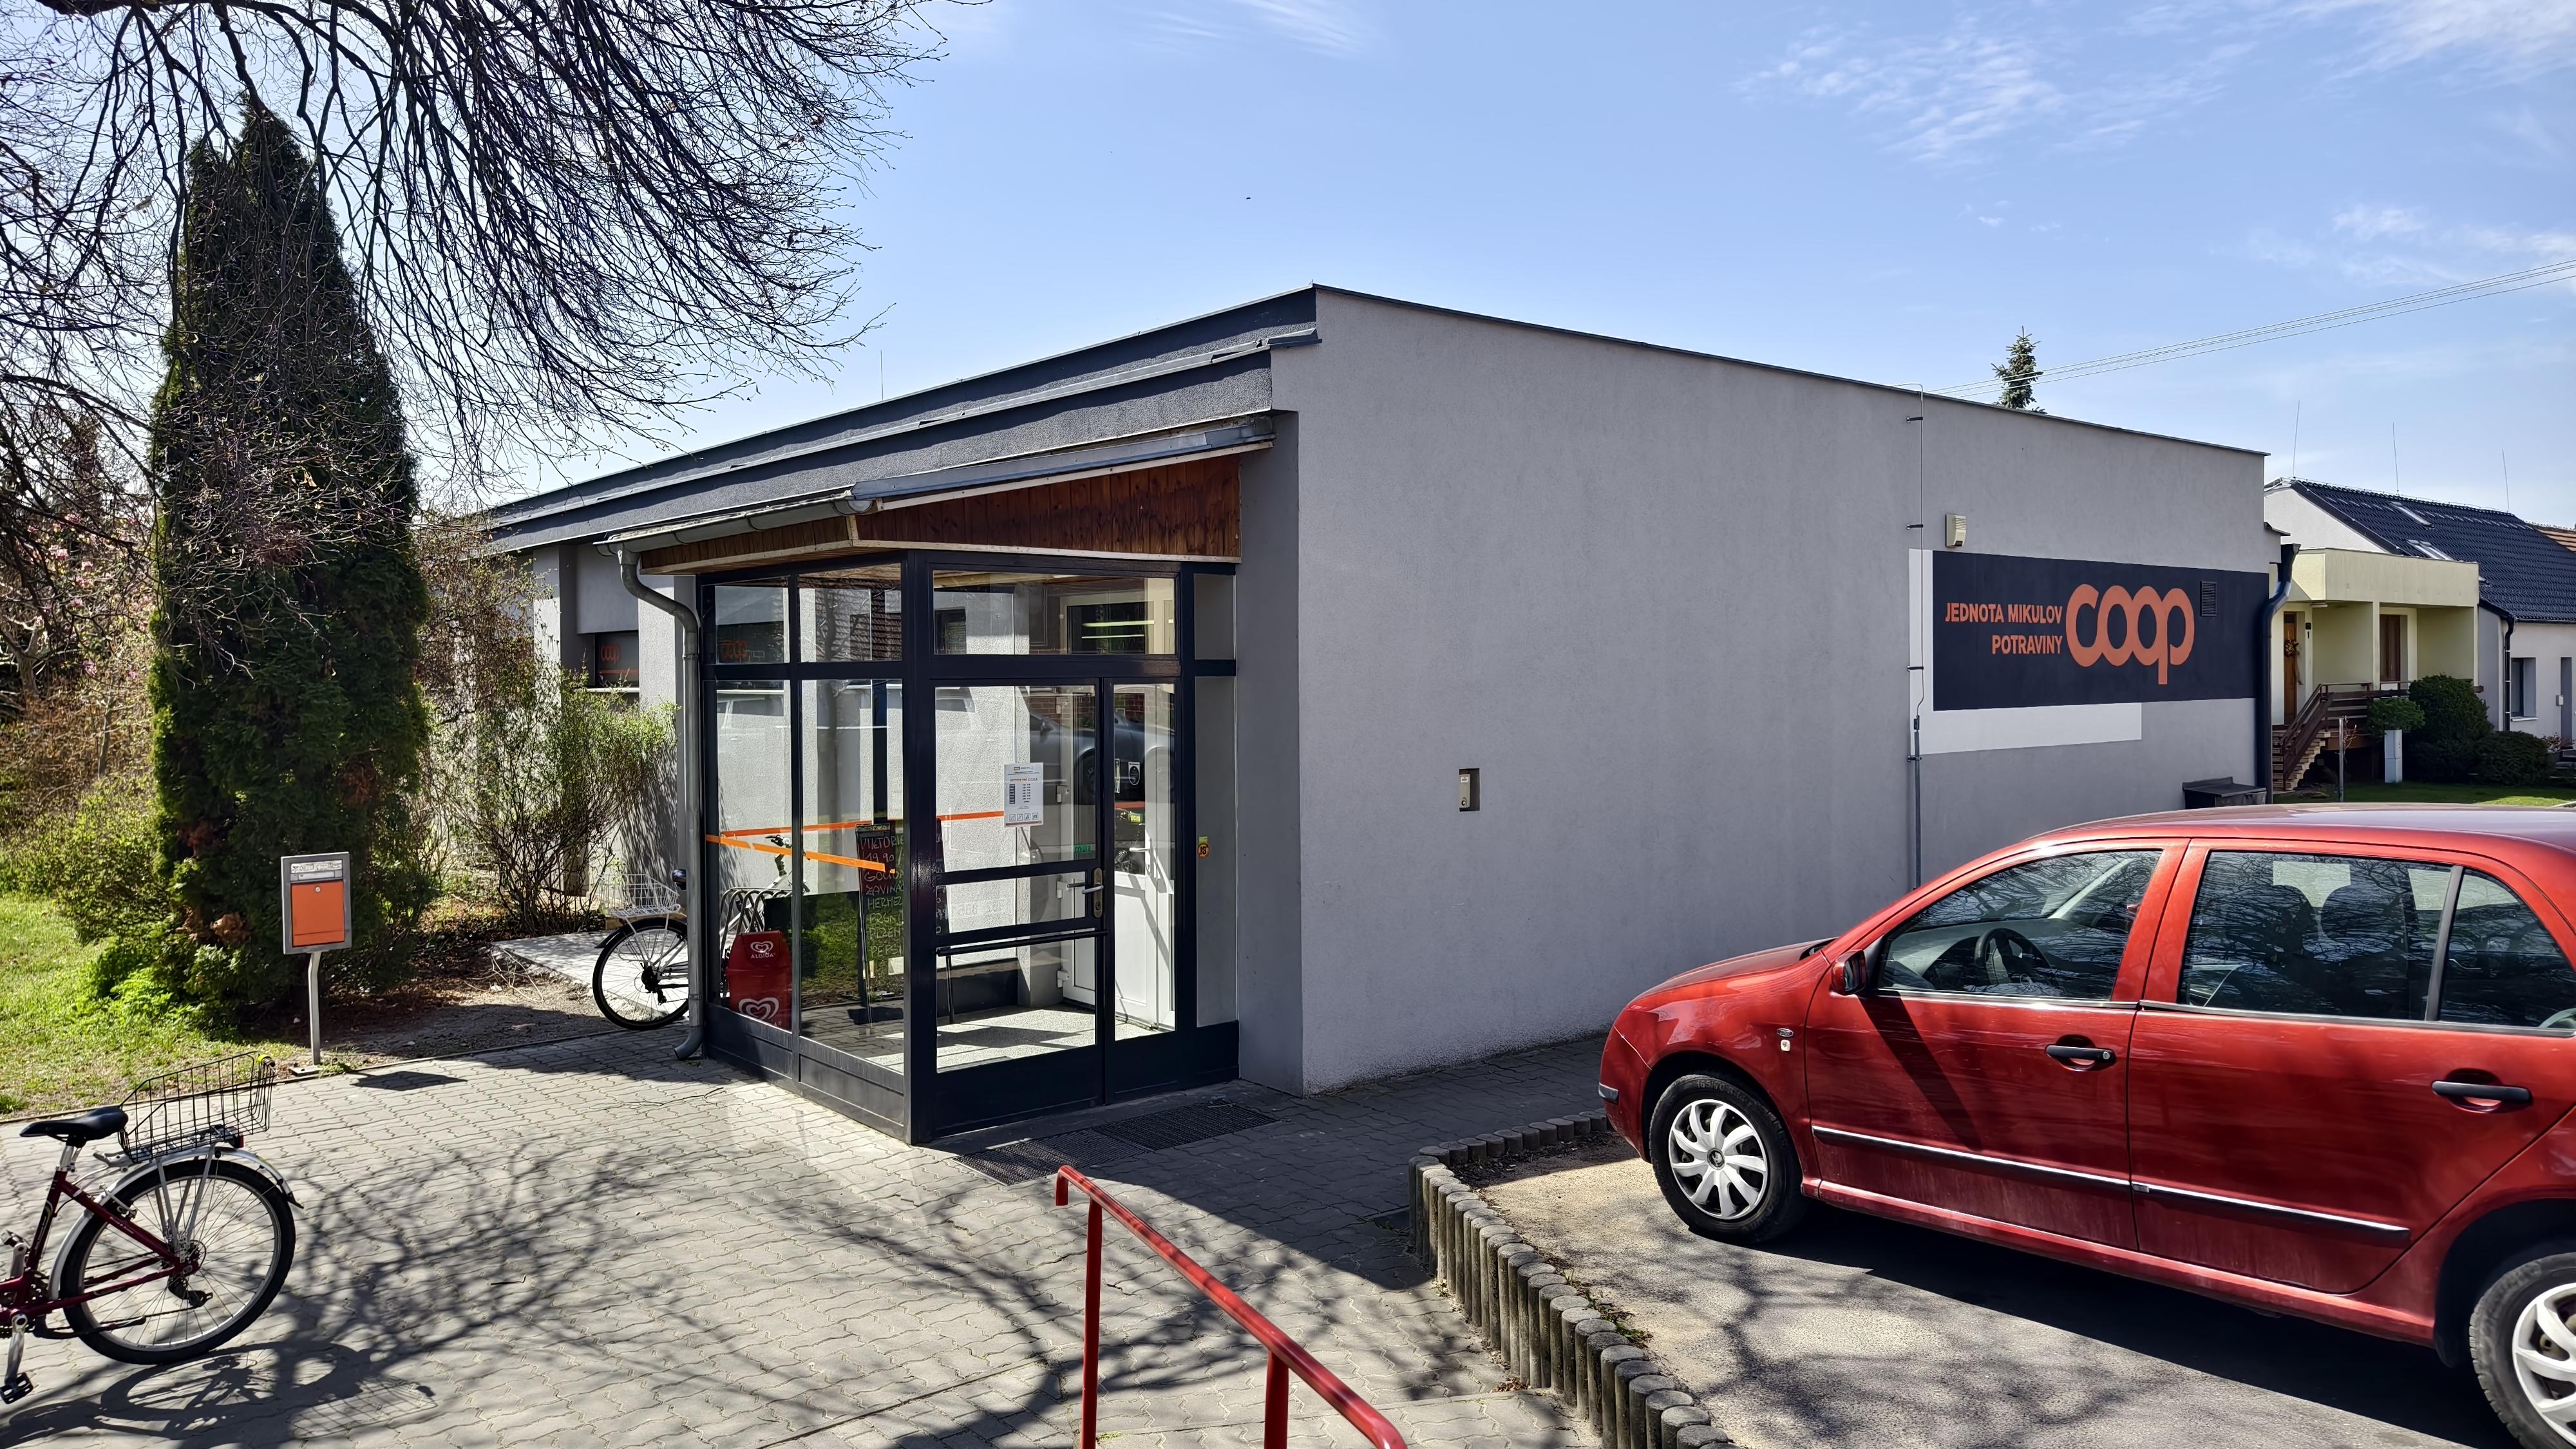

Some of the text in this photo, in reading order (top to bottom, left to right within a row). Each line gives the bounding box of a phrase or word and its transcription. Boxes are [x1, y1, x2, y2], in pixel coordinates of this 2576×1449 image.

[1945, 602, 2063, 624] JEDNOTA MIKULOV
[1992, 634, 2063, 655] POTRAVINY
